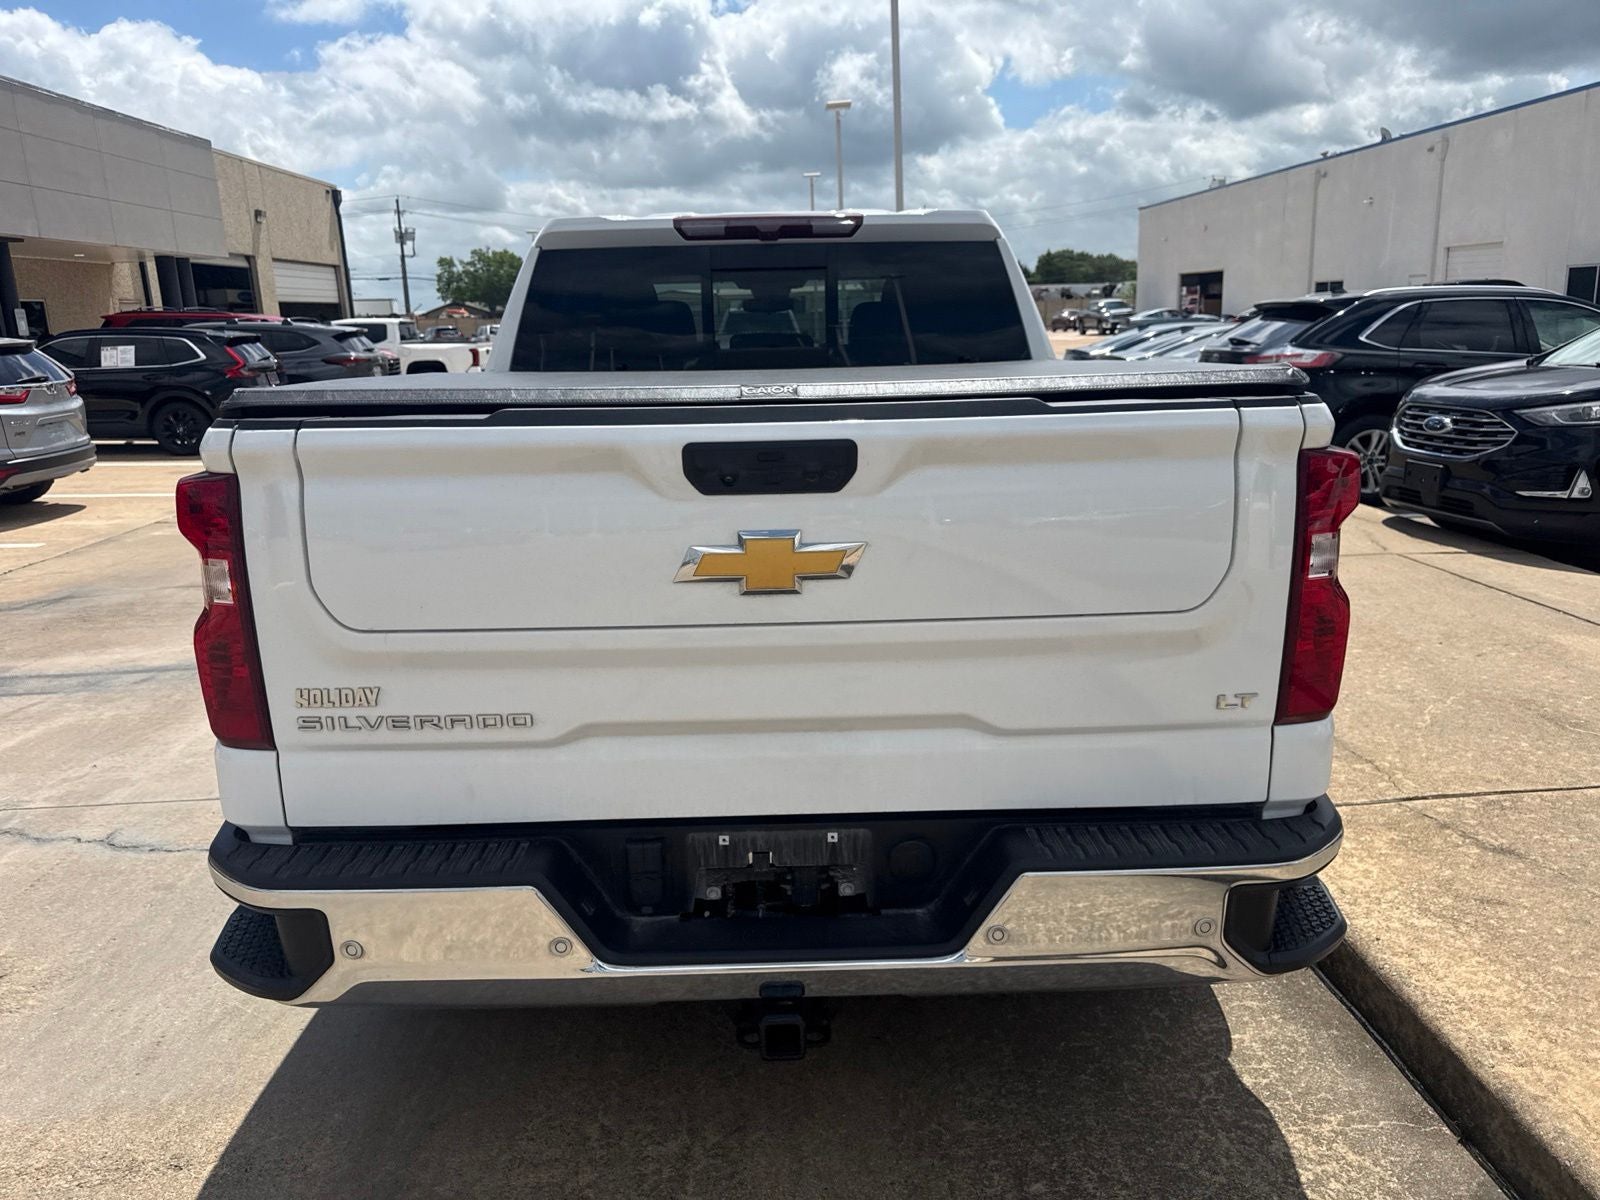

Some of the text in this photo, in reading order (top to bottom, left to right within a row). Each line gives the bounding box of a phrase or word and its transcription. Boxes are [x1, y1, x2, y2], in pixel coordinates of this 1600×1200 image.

[295, 686, 381, 708] HOLIDAY
[1215, 692, 1259, 710] LT
[296, 712, 535, 732] SILVERADO
